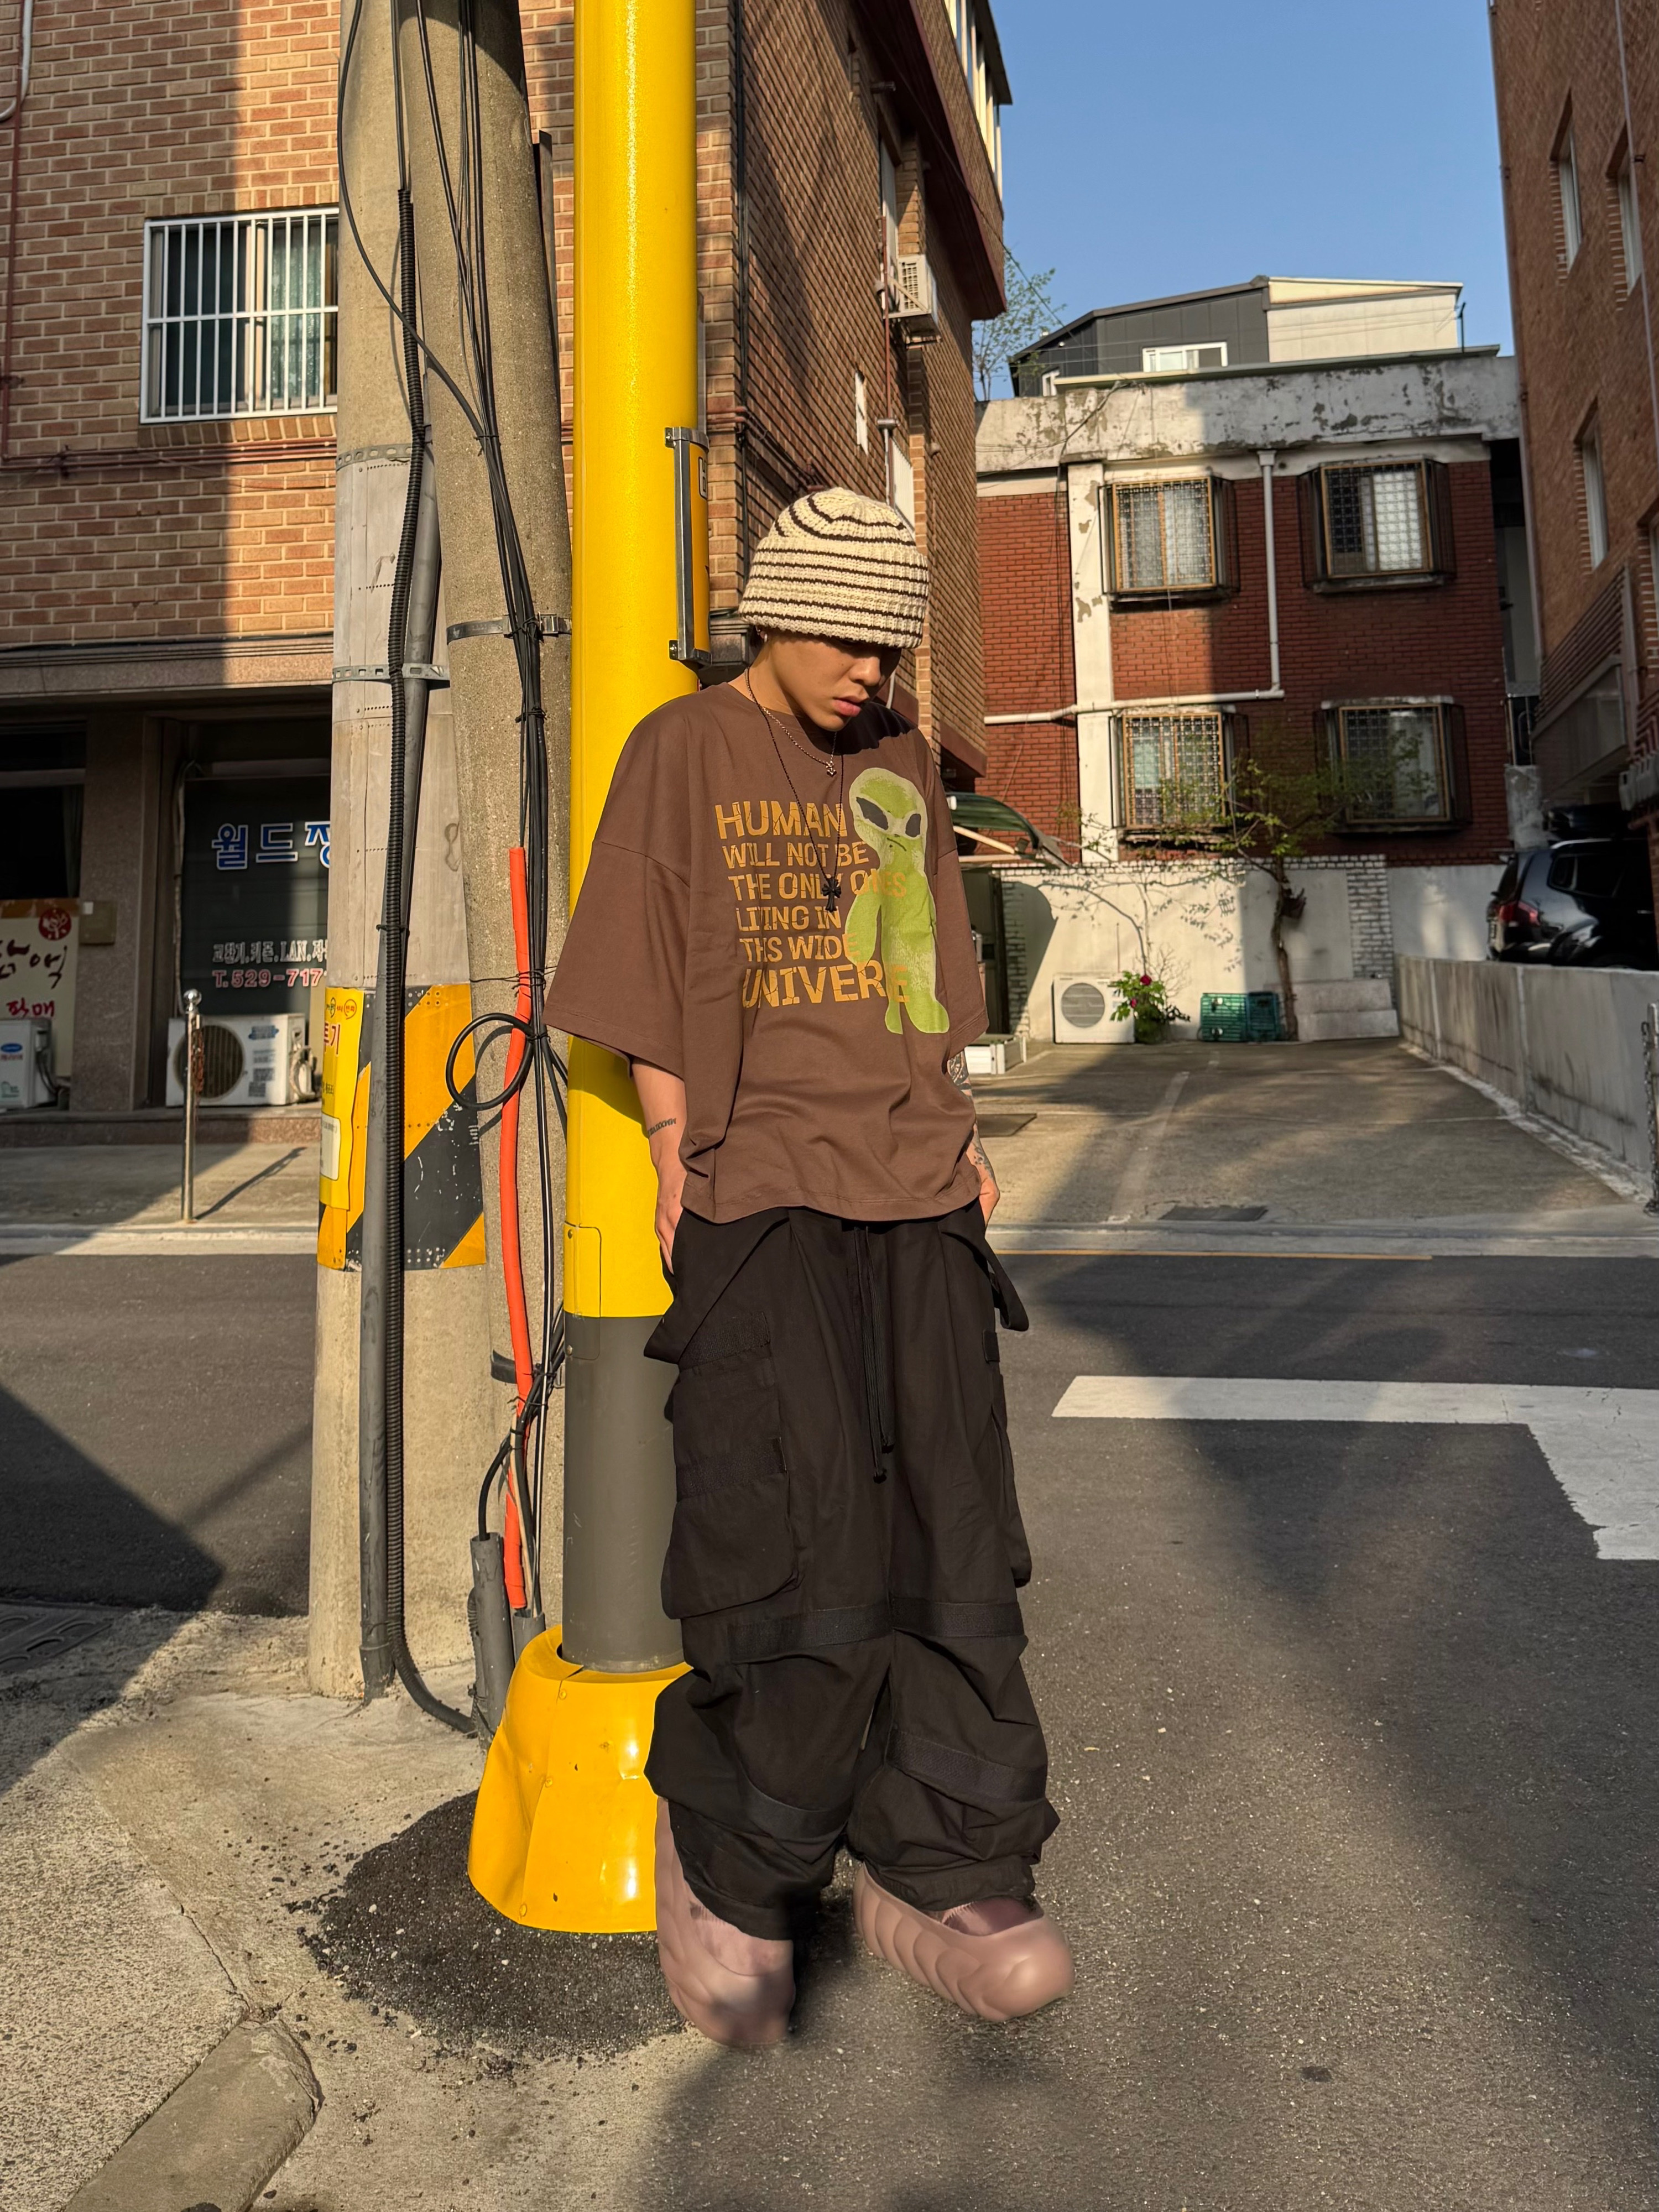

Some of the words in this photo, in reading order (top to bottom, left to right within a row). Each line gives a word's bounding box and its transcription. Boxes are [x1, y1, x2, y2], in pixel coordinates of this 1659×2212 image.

[715, 801, 848, 839] HUMAN
[722, 842, 780, 869] WILL
[787, 842, 828, 867] NOT
[835, 841, 869, 867] BE
[728, 873, 771, 901] THE
[814, 905, 842, 930] IN
[787, 932, 861, 960] WIDE
[212, 968, 327, 988] T.529-717
